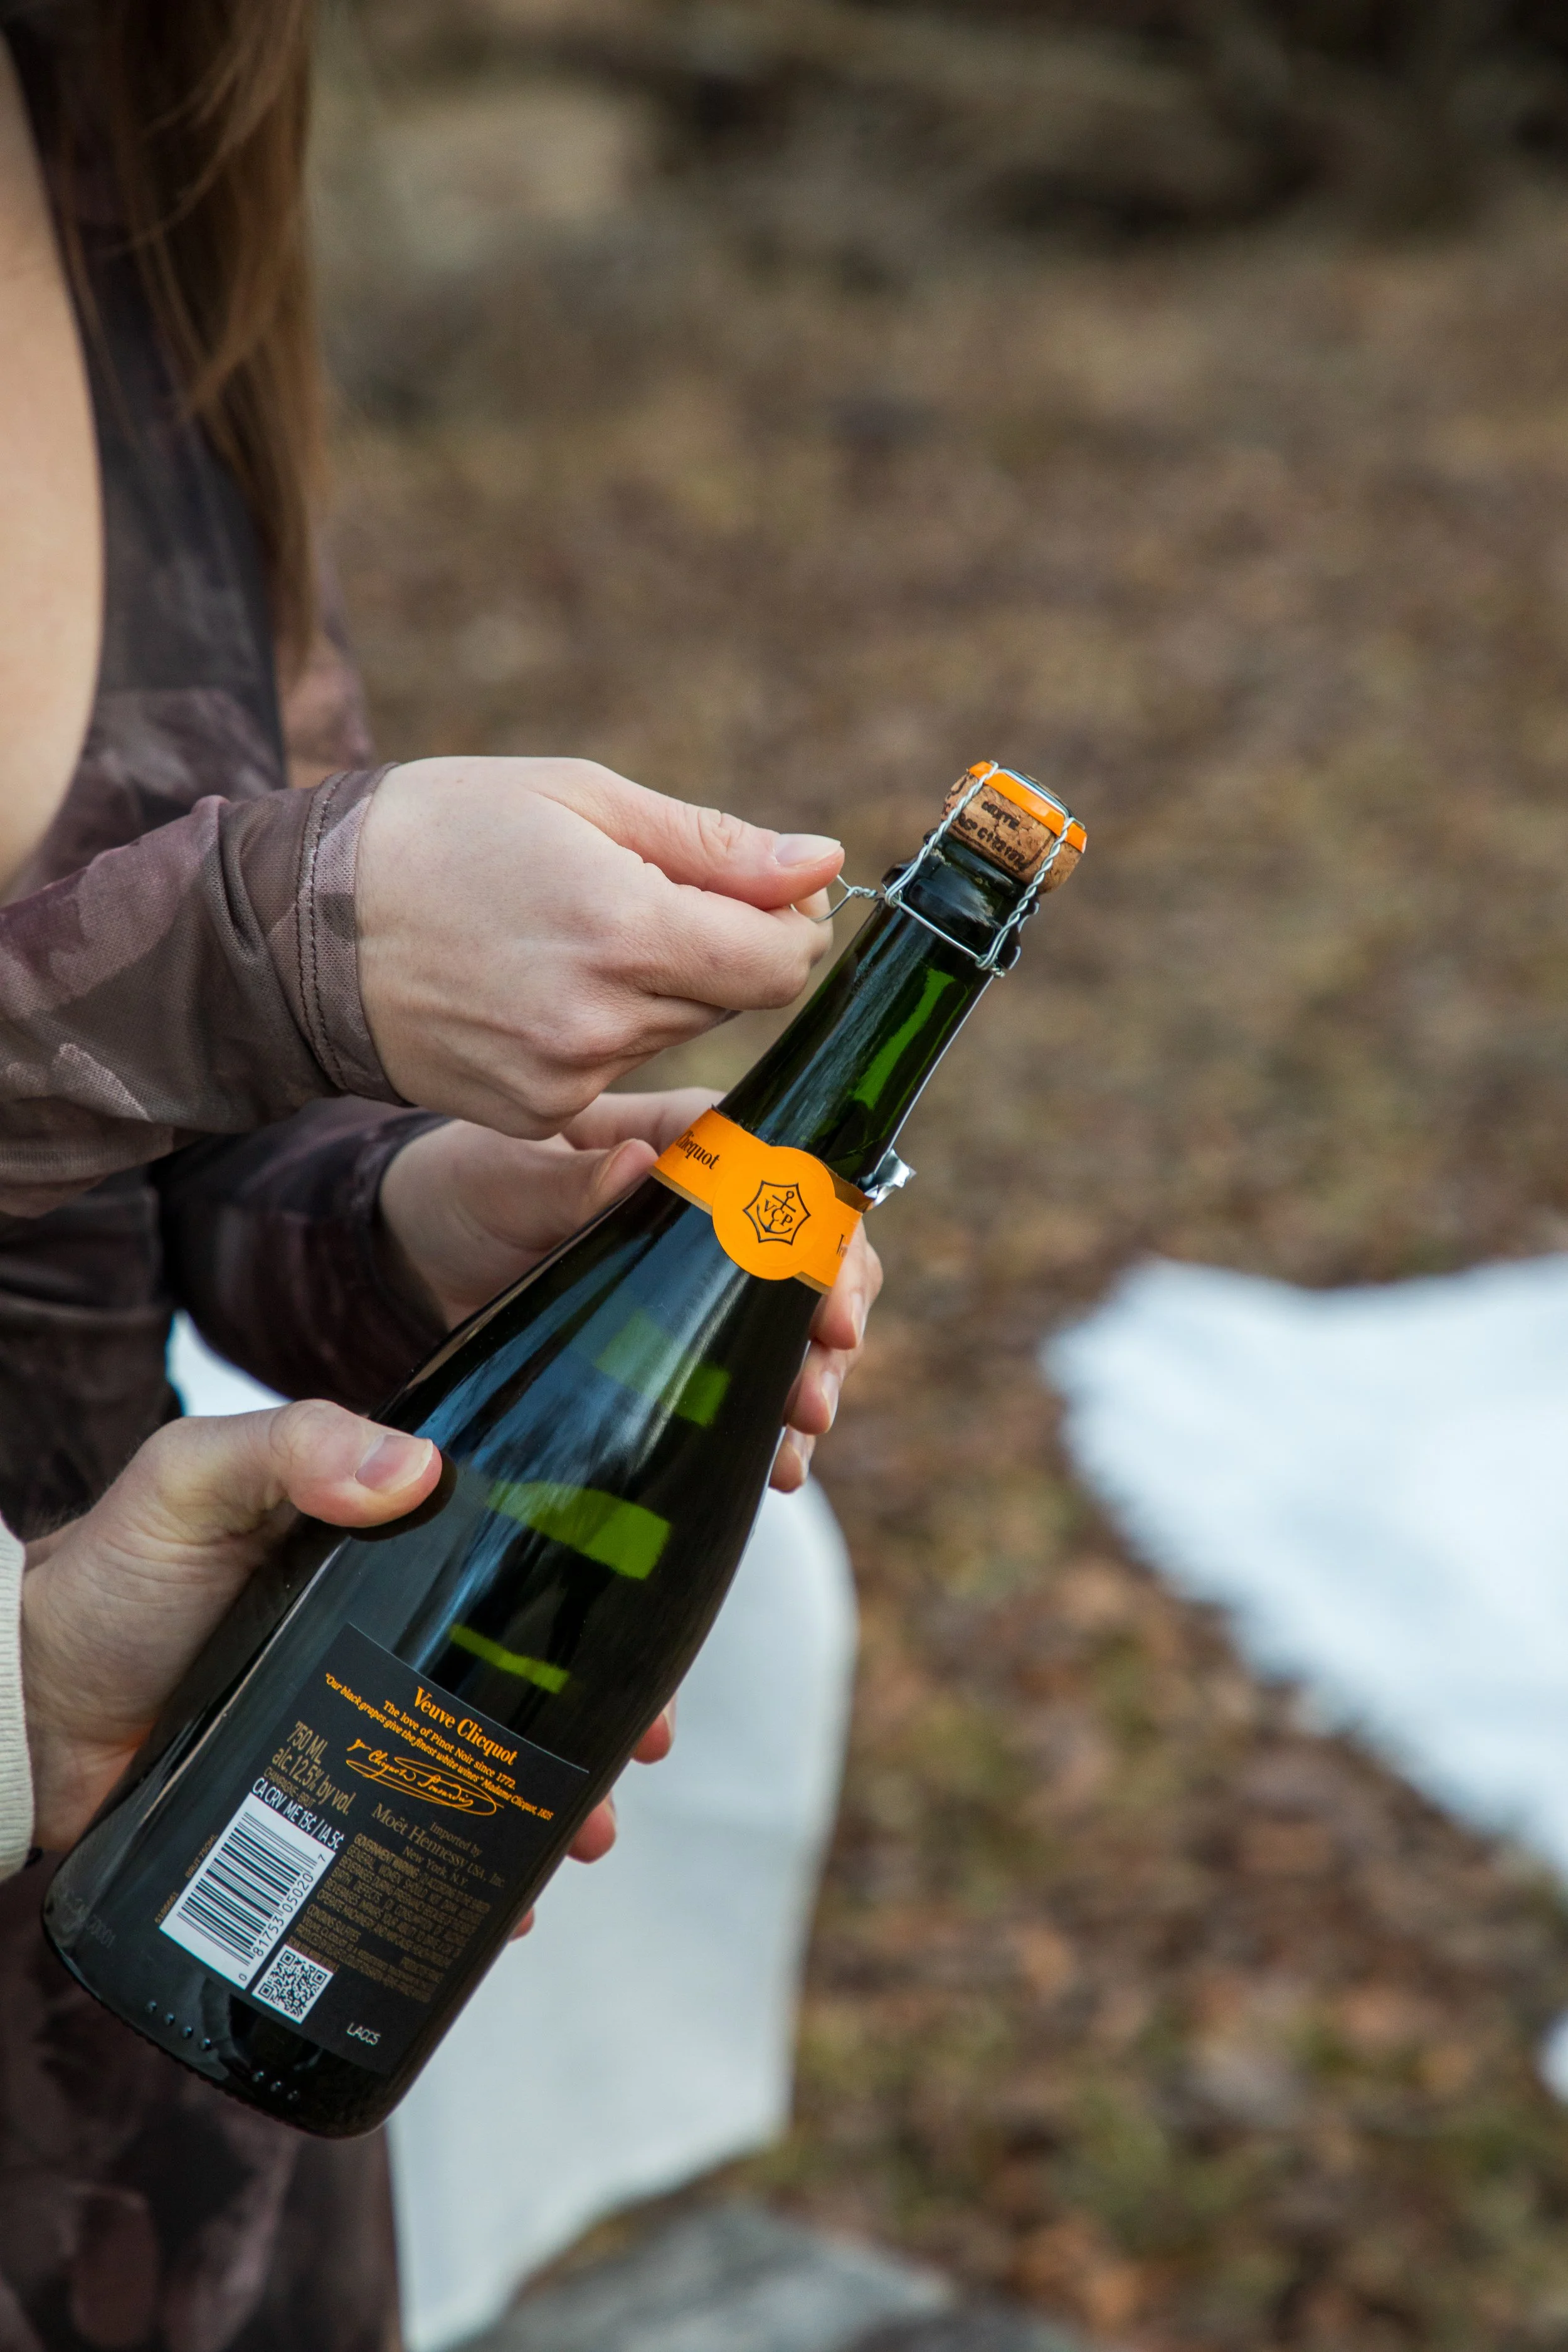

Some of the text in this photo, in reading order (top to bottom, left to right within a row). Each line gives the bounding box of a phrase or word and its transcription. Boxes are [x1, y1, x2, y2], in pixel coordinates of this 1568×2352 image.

[287, 1720, 328, 1765] 750 ML
[340, 1685, 362, 1705] black
[358, 1702, 387, 1723] grapes
[383, 1720, 403, 1734] give
[401, 1729, 416, 1745] the
[411, 1737, 437, 1757] finest
[436, 1752, 459, 1769] white
[481, 1778, 512, 1800] Madame
[383, 1700, 516, 1789] The love of Pinot Noir since 1772.
[415, 1687, 517, 1766] Veuve Clicquot
[252, 1777, 268, 1798] CA
[264, 1786, 287, 1809] CRV
[283, 1800, 304, 1823] ME
[294, 1810, 317, 1832] 15¢
[317, 1824, 332, 1844] IA
[327, 1830, 344, 1851] 5¢
[272, 1746, 356, 1816] alc. 12.5% by vol.
[297, 1791, 317, 1808] BRUT
[371, 1803, 408, 1835] Moët
[407, 1825, 465, 1867] Hennessy
[402, 1845, 425, 1863] New
[429, 1821, 482, 1858] Imported by
[238, 1853, 326, 1982] 0 81753 05020 7
